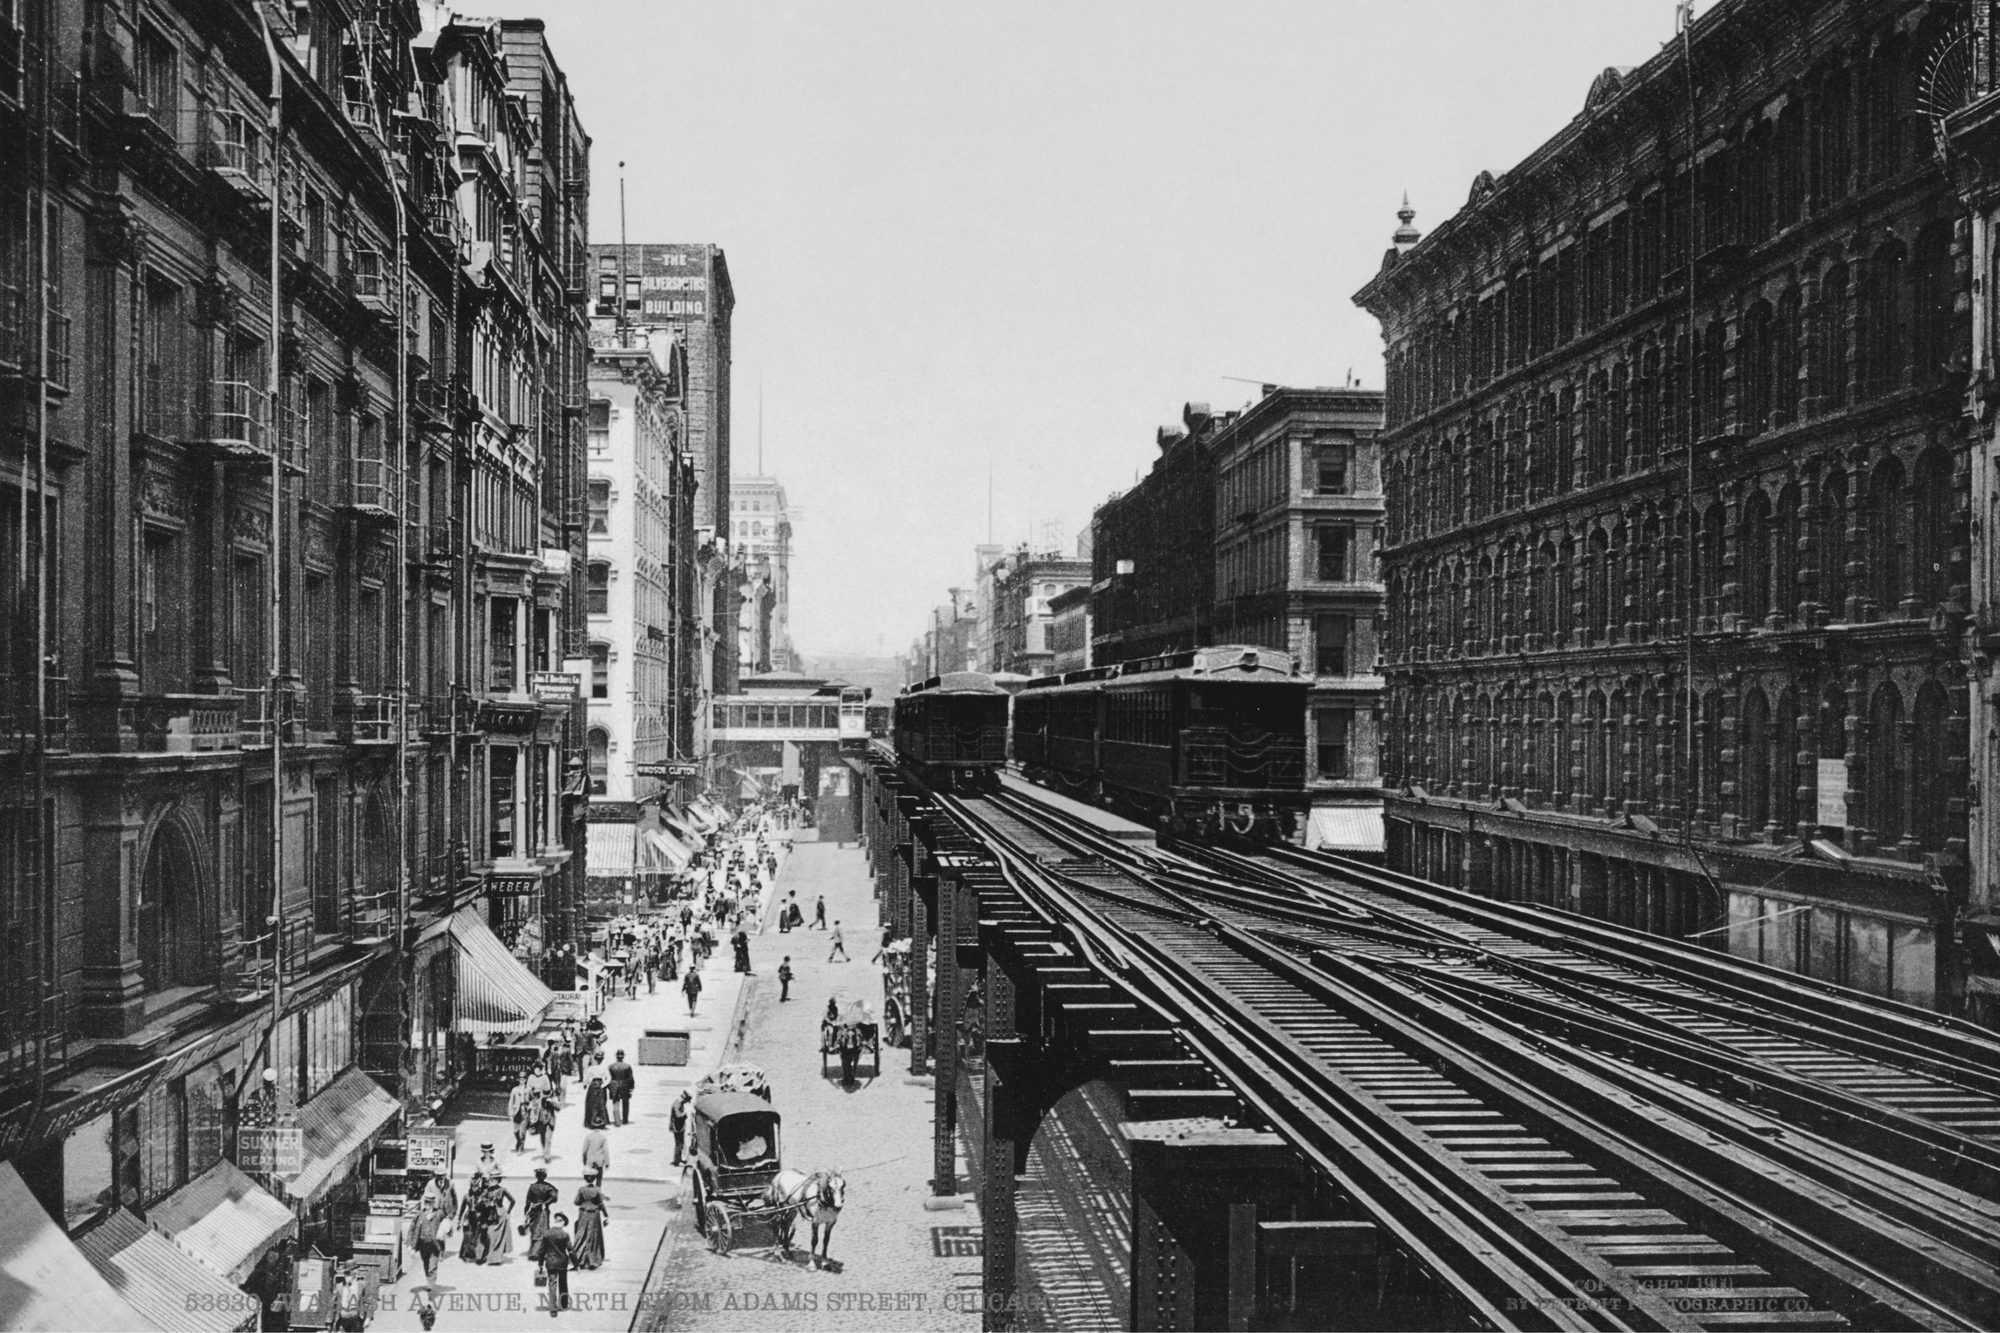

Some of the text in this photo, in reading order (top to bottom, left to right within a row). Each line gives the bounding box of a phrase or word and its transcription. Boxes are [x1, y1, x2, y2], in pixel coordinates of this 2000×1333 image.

[663, 254, 687, 266] THE
[642, 276, 706, 291] SILVERSMITHS
[668, 766, 696, 776] CLIFTON
[490, 881, 530, 893] WEBER
[240, 1136, 300, 1150] SUMMER
